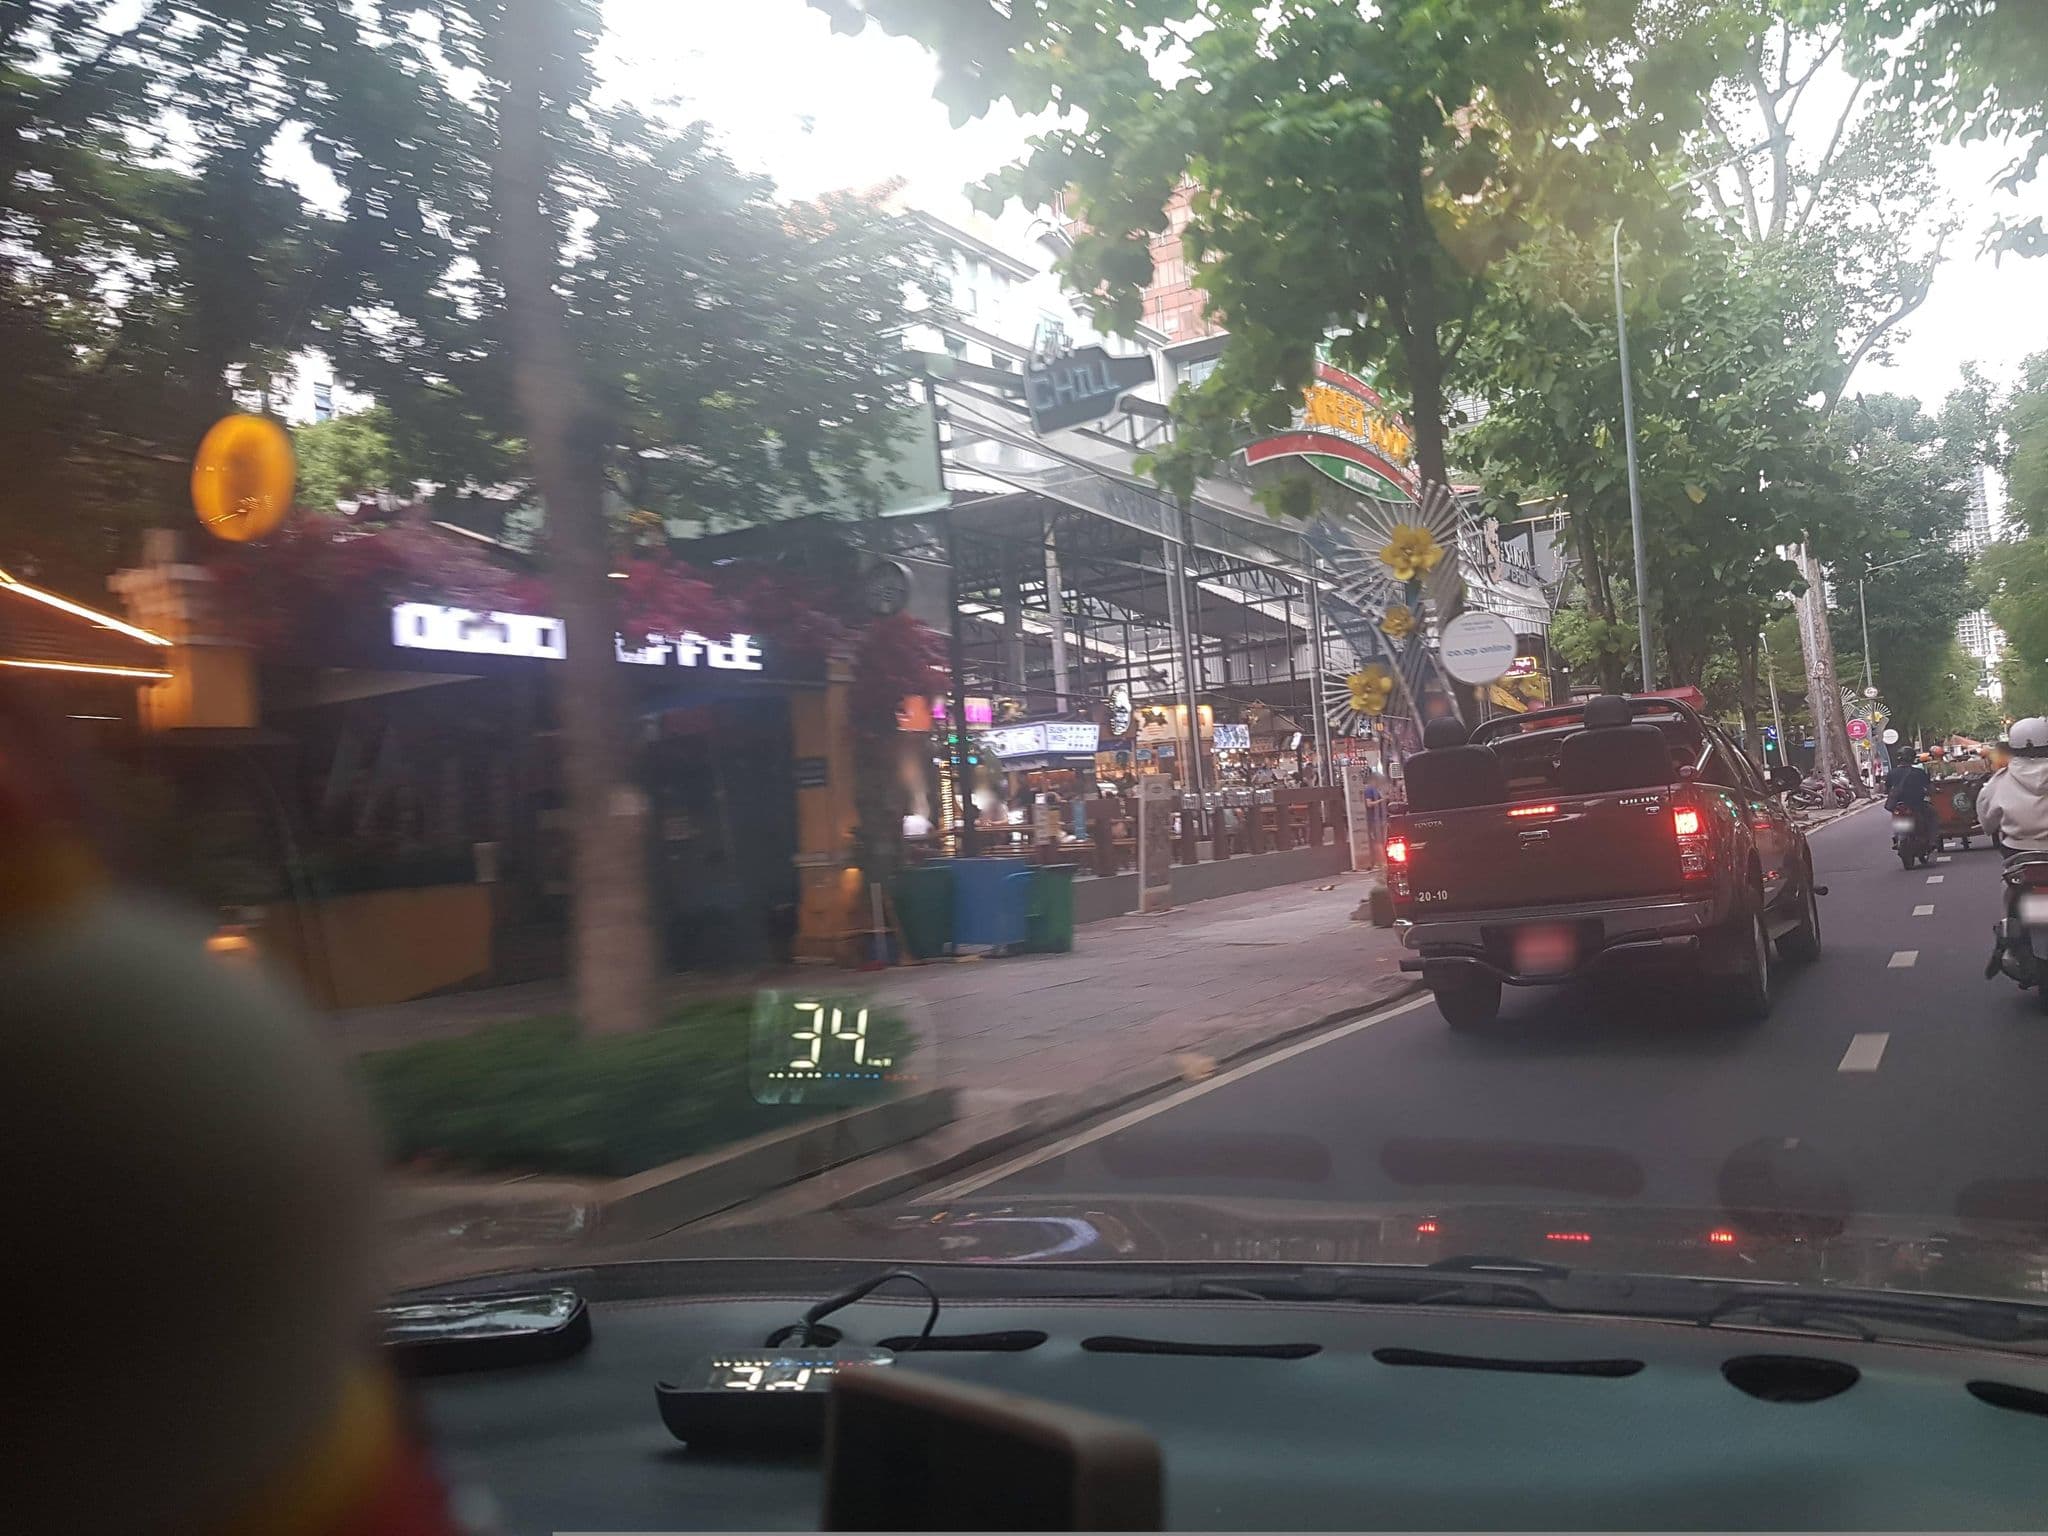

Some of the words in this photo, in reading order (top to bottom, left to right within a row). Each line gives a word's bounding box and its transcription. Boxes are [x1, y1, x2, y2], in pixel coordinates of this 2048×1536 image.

[1030, 359, 1121, 411] CHILL
[1480, 644, 1512, 654] online
[1414, 821, 1444, 829] TOYOTA
[1418, 890, 1448, 902] 20-10
[790, 1002, 868, 1068] 34
